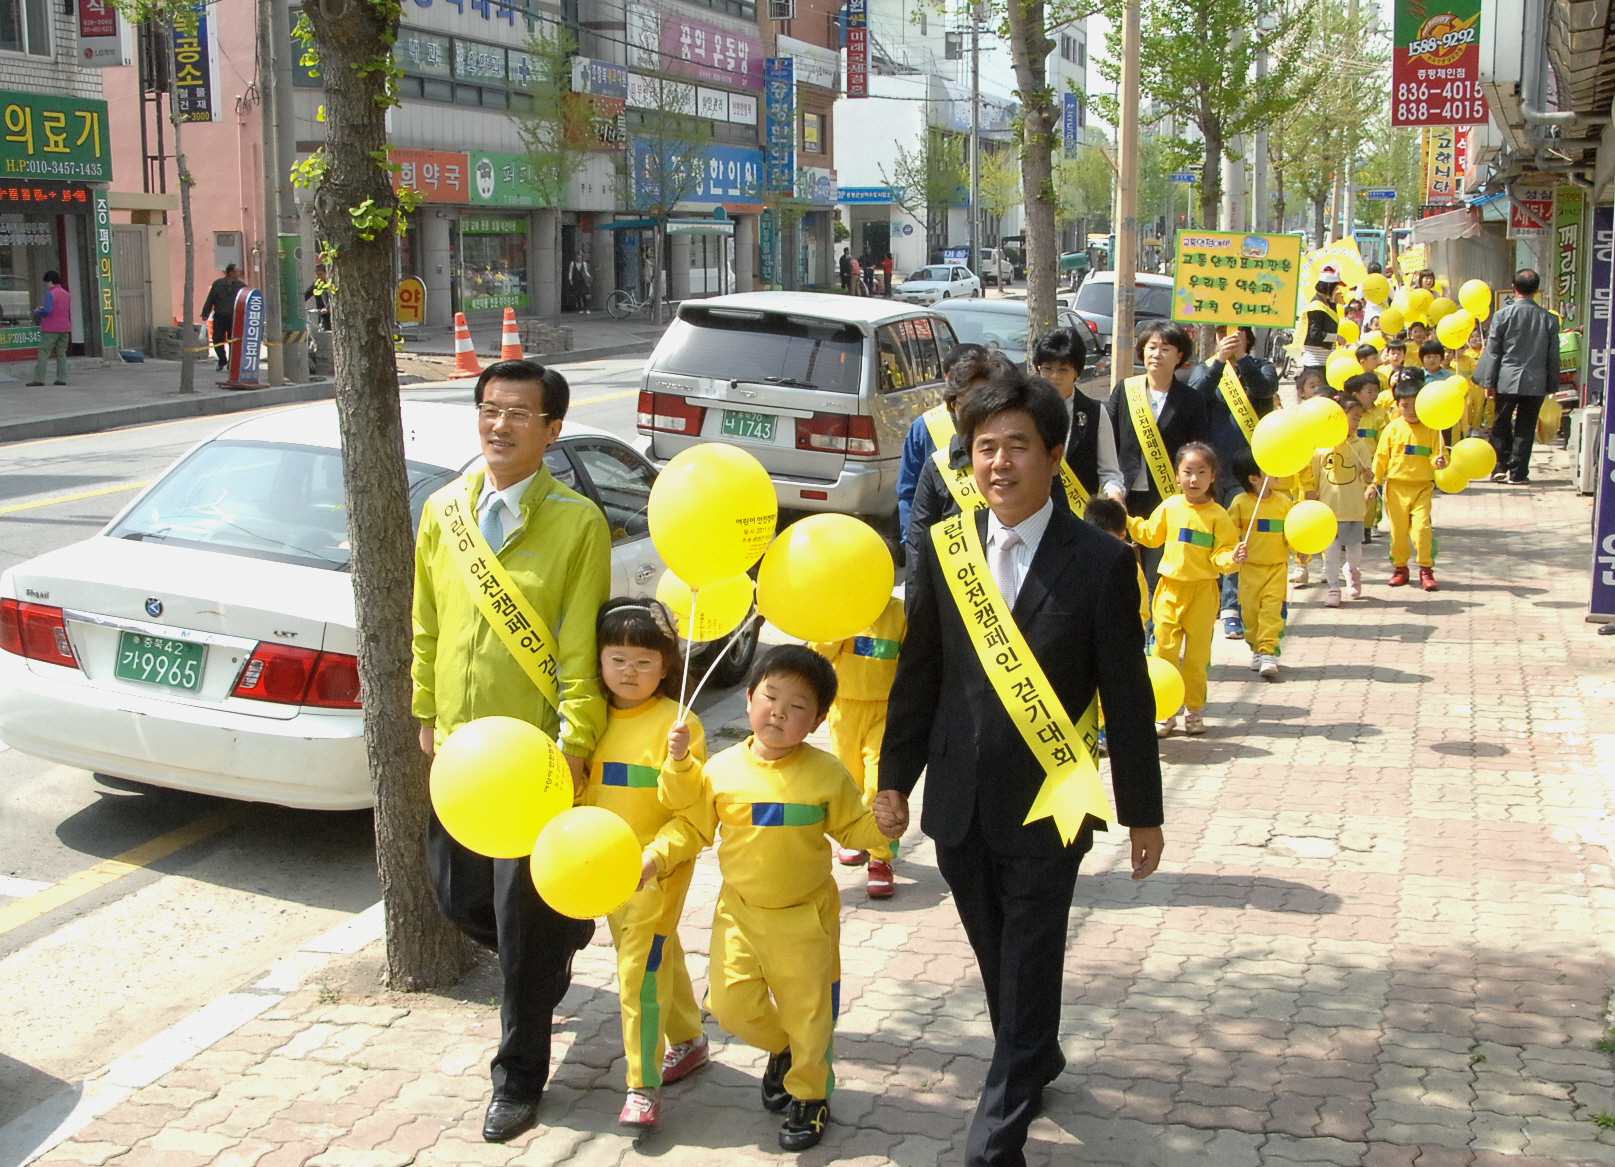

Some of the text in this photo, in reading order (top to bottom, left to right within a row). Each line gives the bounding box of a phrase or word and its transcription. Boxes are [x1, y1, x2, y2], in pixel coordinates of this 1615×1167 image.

[1417, 68, 1466, 80] 증평체인점
[1398, 80, 1484, 101] 836-4015
[1397, 100, 1483, 120] 838-4015
[4, 104, 101, 158] 의료기
[388, 162, 461, 191] 희약국
[1189, 275, 1274, 294] 우리들 약속과
[400, 289, 421, 318] 약
[1194, 300, 1219, 313] 규칙
[244, 296, 262, 371] 증평의료기
[1135, 407, 1164, 461] 안전캠페인
[444, 499, 475, 552] 어린이
[470, 557, 545, 654] 안전캠페인
[122, 650, 198, 690] 가9965
[957, 562, 1023, 674] 안전캠페인
[1011, 676, 1078, 768] 걷기대회
